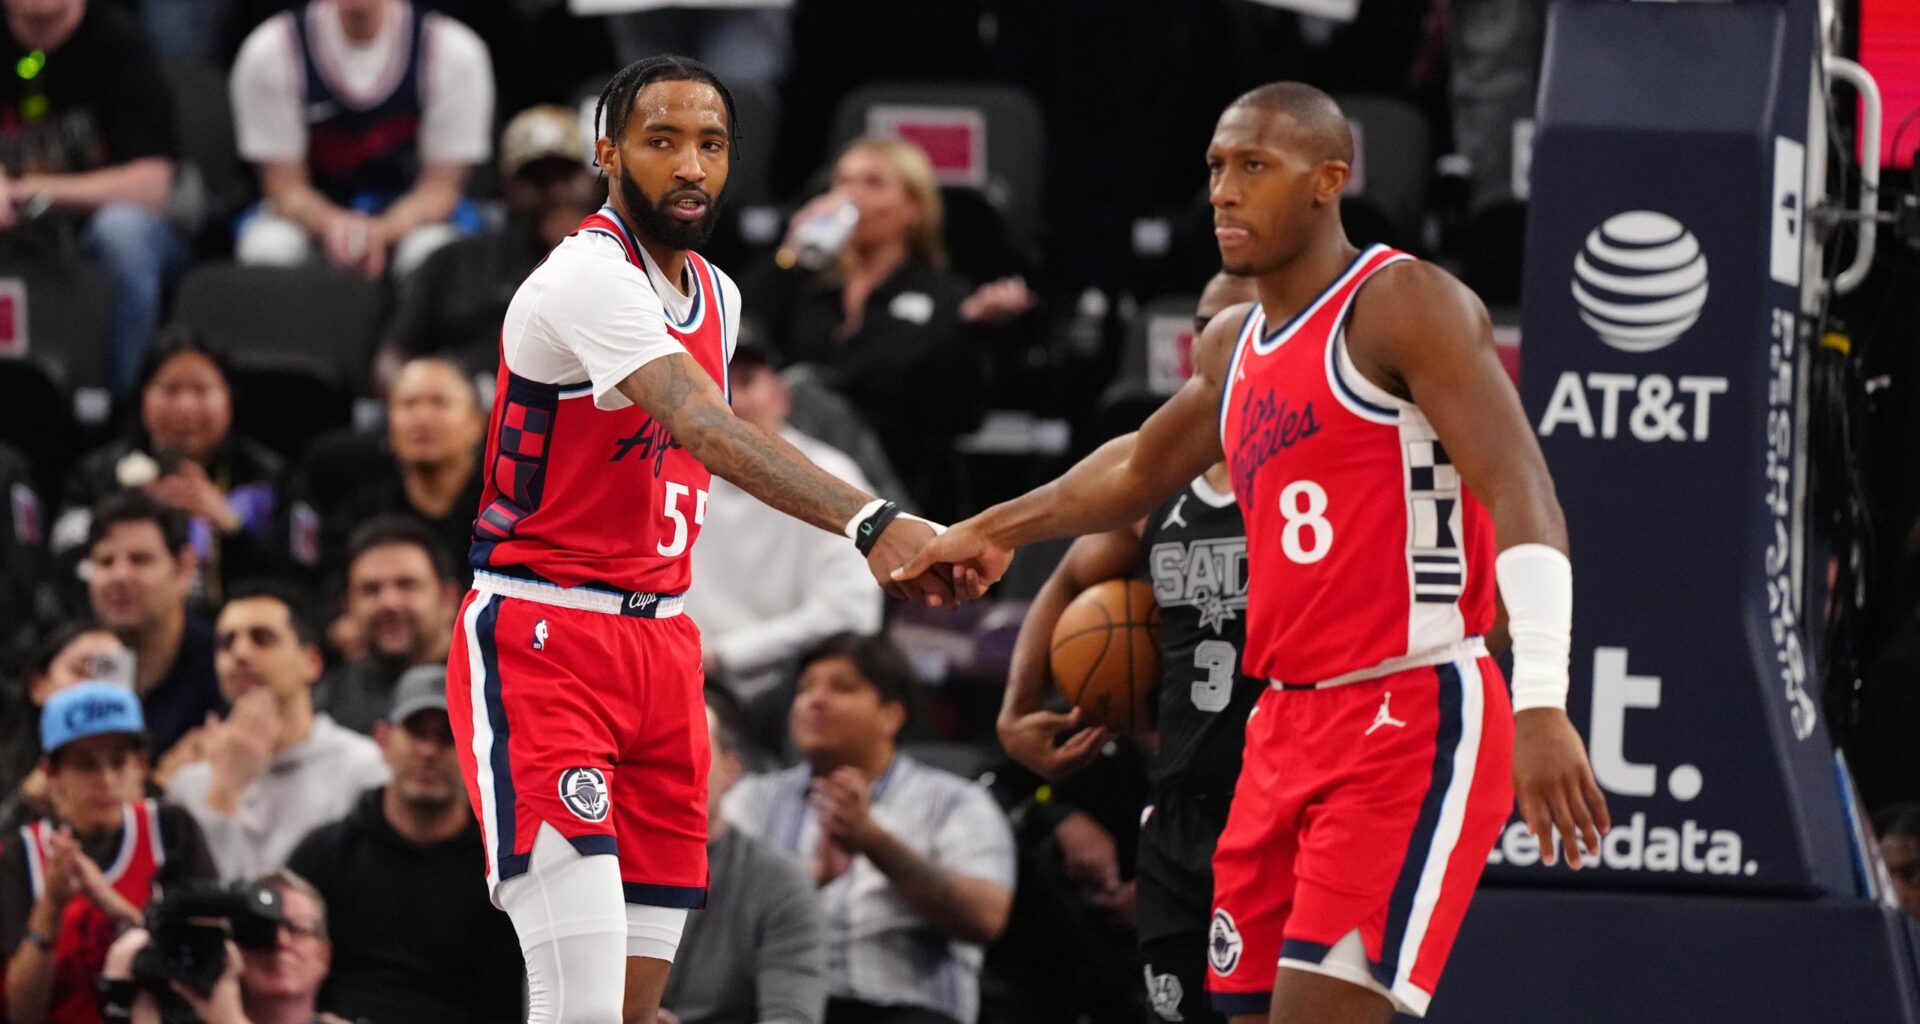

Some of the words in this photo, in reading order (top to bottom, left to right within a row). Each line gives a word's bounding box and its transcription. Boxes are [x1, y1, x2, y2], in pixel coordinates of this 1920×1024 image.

[1239, 387, 1276, 448] Los
[1538, 371, 1729, 442] AT&T
[1279, 479, 1334, 565] 8
[1150, 536, 1250, 609] SAT
[1190, 639, 1238, 713] 3
